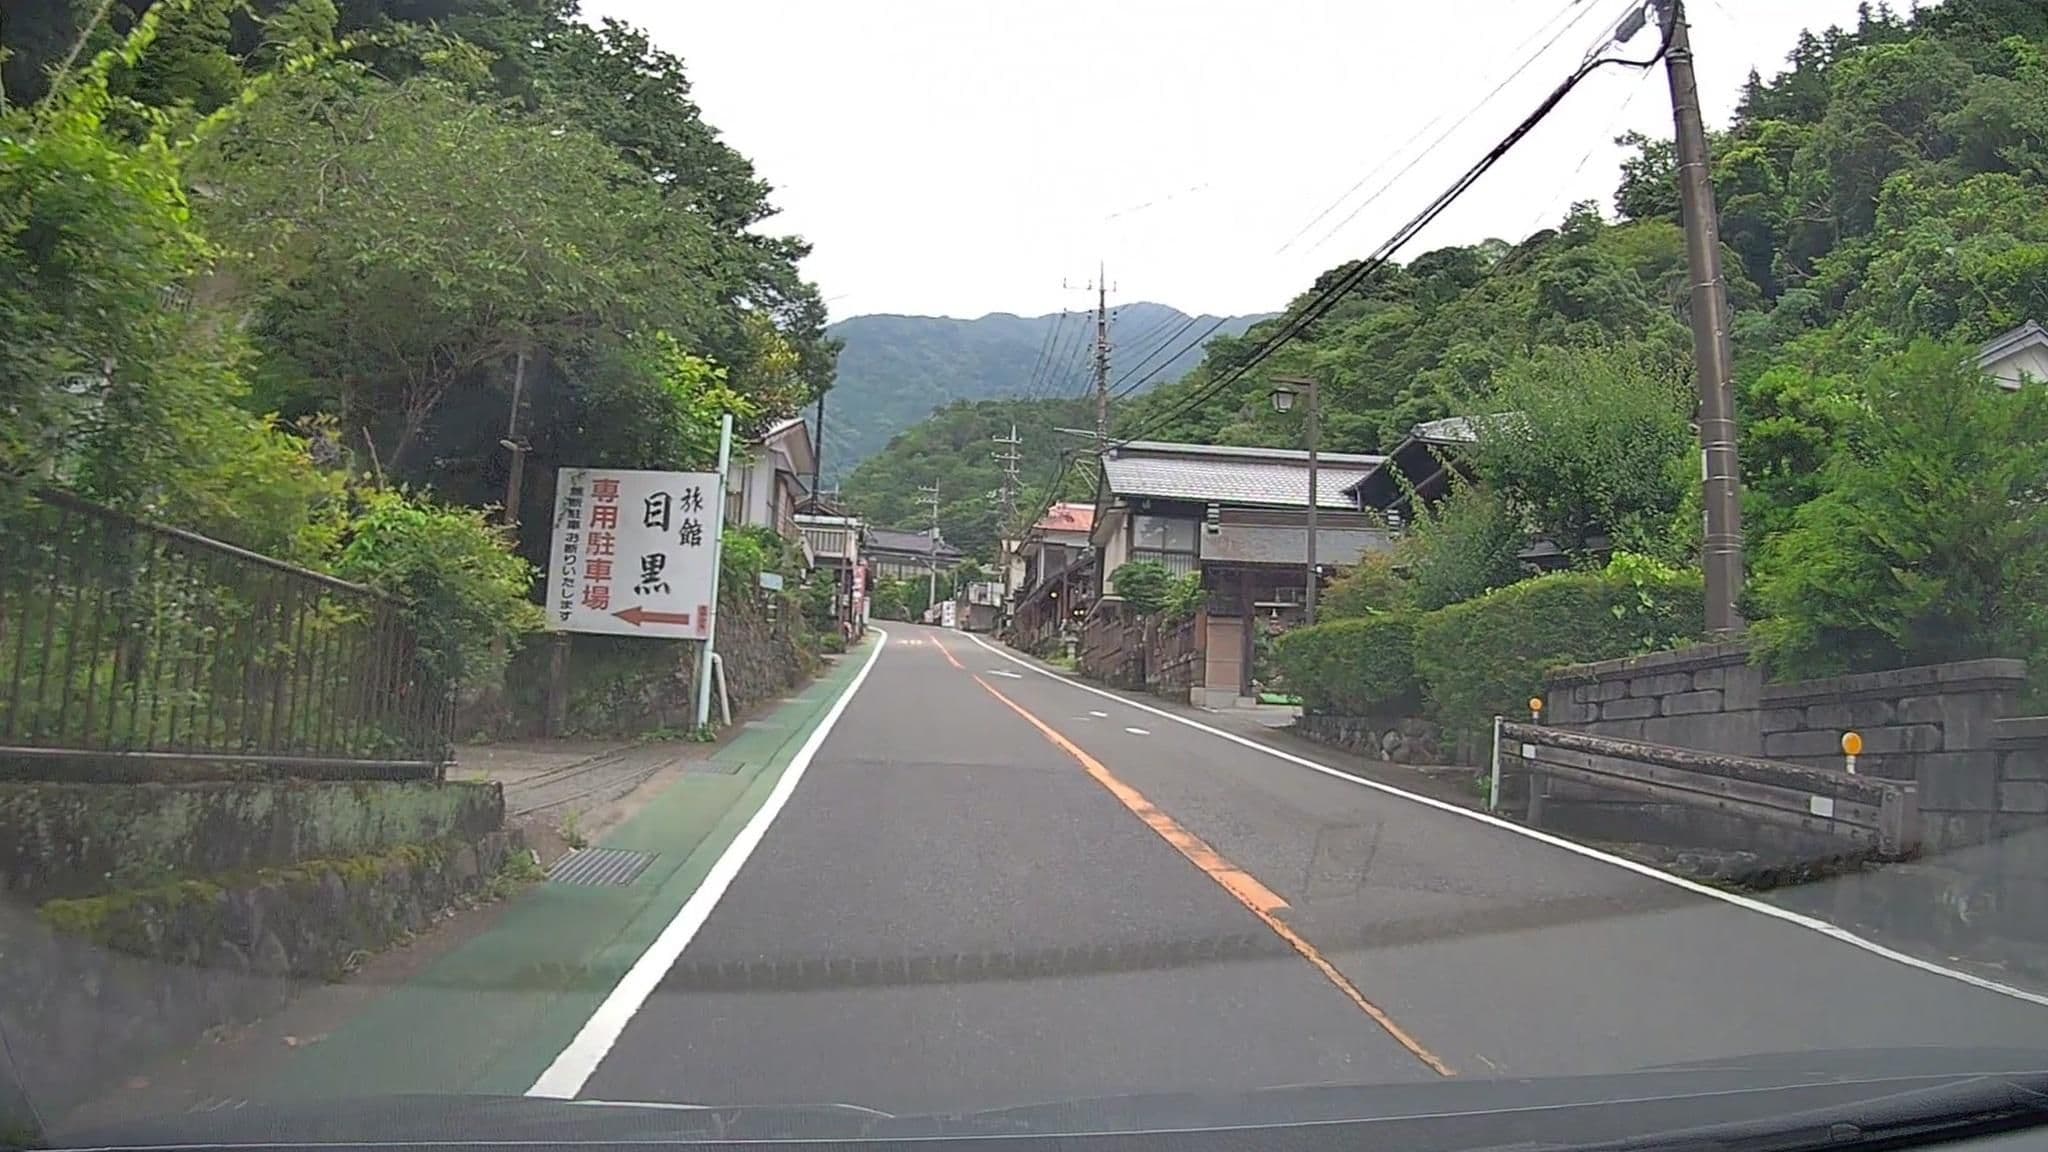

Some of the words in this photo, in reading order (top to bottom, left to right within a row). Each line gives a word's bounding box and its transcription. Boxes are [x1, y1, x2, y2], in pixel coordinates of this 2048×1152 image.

[559, 487, 584, 621] 無断駐車お断りいたします
[581, 478, 620, 611] 専用駐車場
[634, 491, 672, 595] 目黒
[679, 486, 704, 547] 旅館
